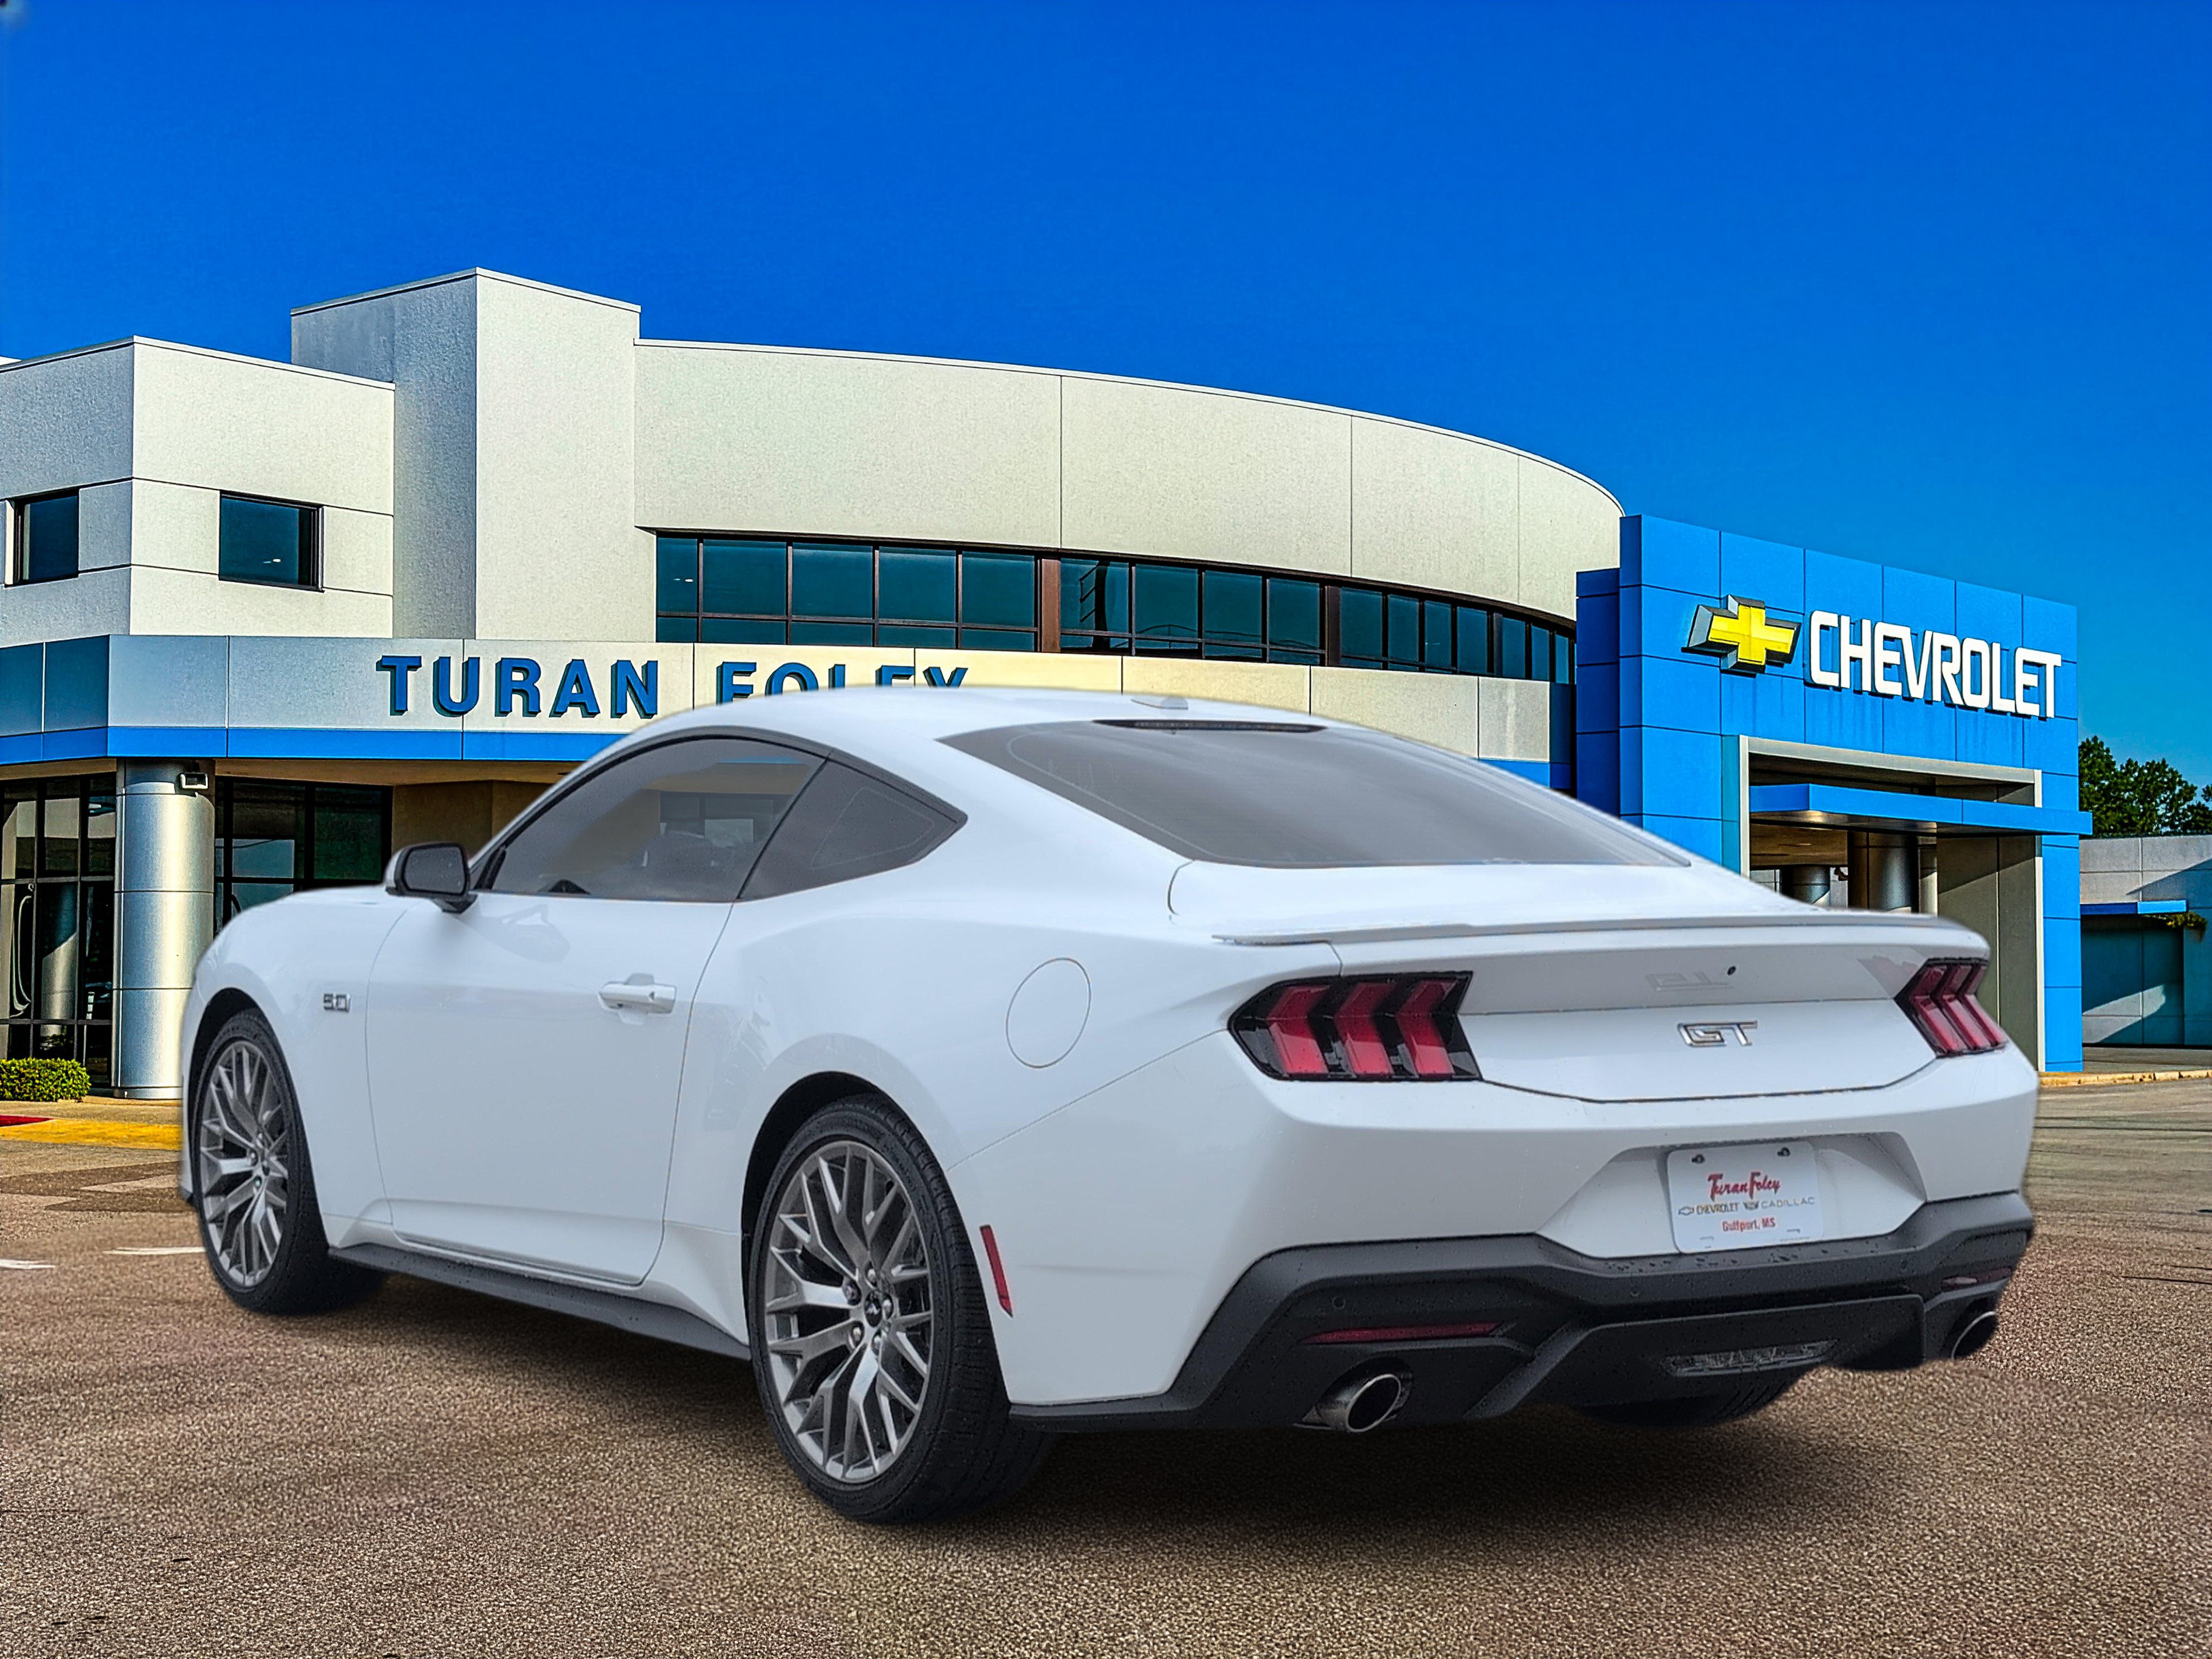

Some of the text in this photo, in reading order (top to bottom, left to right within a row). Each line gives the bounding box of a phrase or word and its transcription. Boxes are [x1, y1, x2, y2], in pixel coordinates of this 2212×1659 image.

[1809, 609, 2062, 719] CHEVROLET
[376, 655, 659, 718] TURAN
[1677, 1020, 1758, 1047] GT
[1760, 1196, 1815, 1209] CADILLAC
[1761, 1217, 1776, 1228] MS
